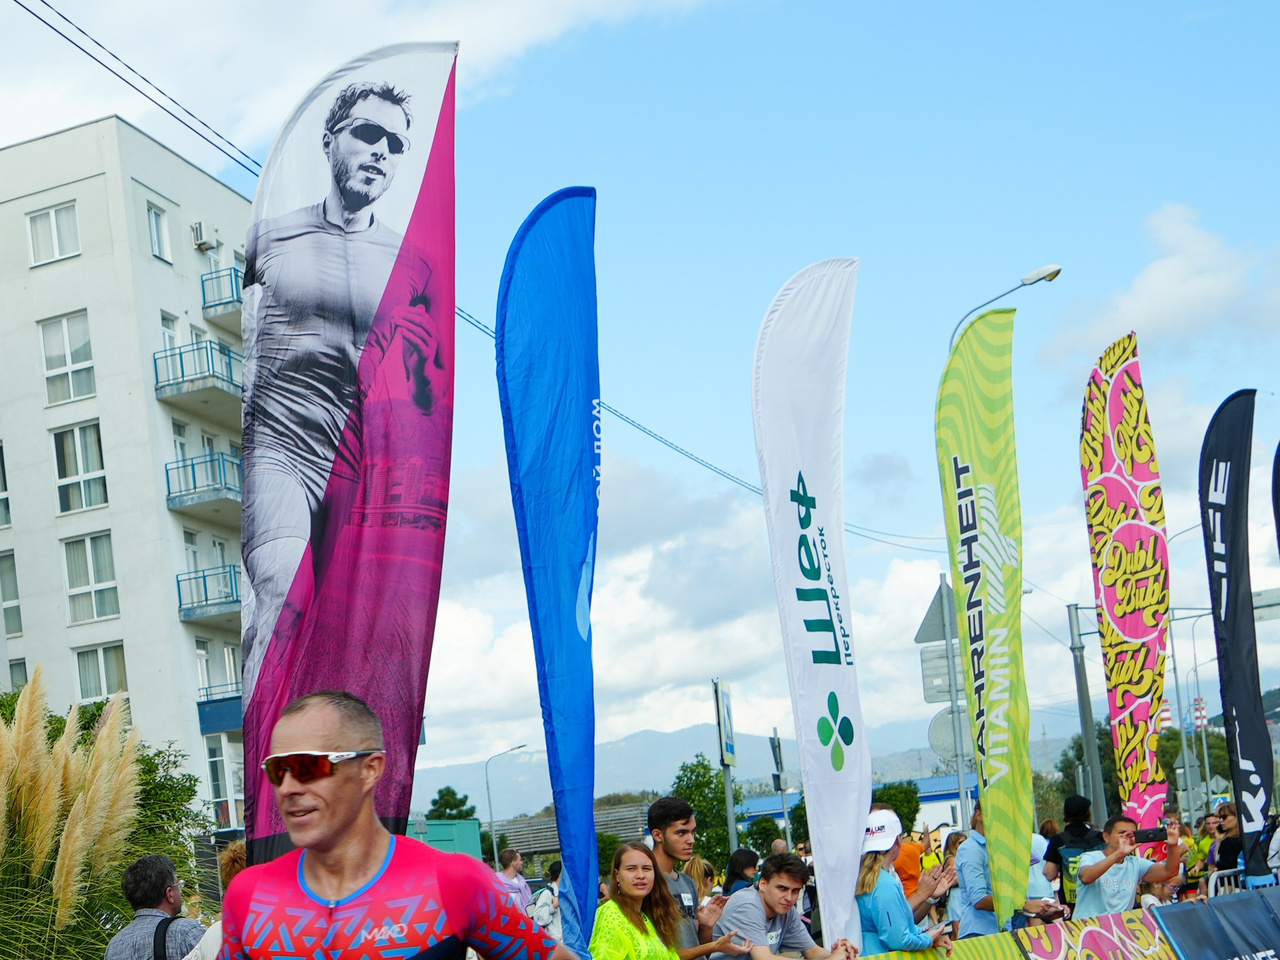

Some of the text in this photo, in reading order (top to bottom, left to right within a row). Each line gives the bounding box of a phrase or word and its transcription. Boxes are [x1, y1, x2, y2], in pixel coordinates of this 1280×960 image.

[790, 470, 842, 665] Шеф
[1101, 534, 1157, 587] Dubl
[1114, 557, 1169, 627] Bubl
[988, 628, 1010, 787] VITAMIN
